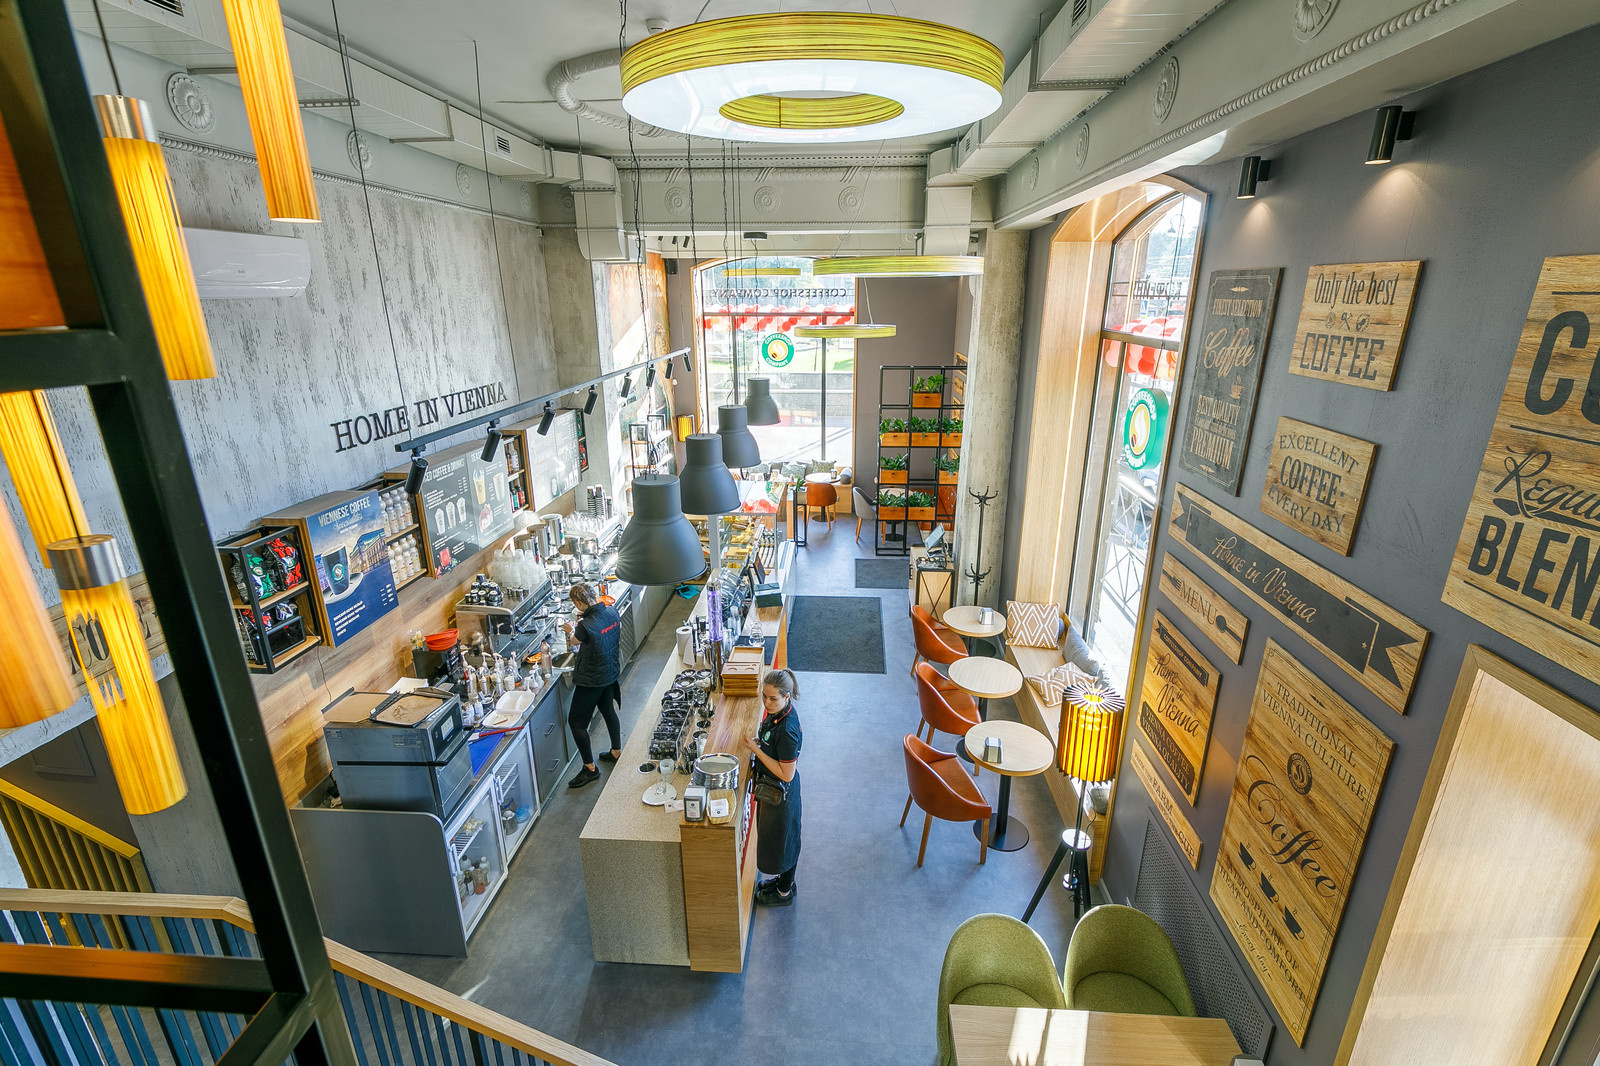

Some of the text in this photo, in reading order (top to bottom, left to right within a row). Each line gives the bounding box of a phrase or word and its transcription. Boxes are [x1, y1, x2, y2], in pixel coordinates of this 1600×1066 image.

[1212, 299, 1263, 318] FINEST SELECTION
[1314, 271, 1400, 309] Only the best
[765, 333, 793, 346] COFFEESHOP
[765, 356, 789, 368] COMPANY
[1203, 327, 1256, 379] Coffee
[1300, 332, 1385, 380] COFFEE
[330, 381, 508, 453] HOME IN VIENNA
[1196, 394, 1241, 427] BEST QUALITY
[1190, 426, 1235, 470] PREMIUM
[1279, 434, 1359, 475] EXCELLENT
[1280, 455, 1342, 509] COFFEE
[318, 496, 371, 528] VIENNESE COFFEE
[1267, 484, 1346, 533] EVERY DAY
[1179, 579, 1219, 626] MENU
[1211, 536, 1317, 624] Home in Vienna
[1153, 653, 1179, 685] Home
[1156, 683, 1199, 738] Vienna
[1276, 682, 1357, 768] TRADITIONAL
[1142, 717, 1190, 791] VIENNA QUALITY
[1145, 706, 1191, 775] VIENNA COFFEE
[1262, 689, 1367, 801] VIENNA CULTURE
[1152, 777, 1173, 816] FARM
[1178, 830, 1195, 858] CUP
[1245, 755, 1337, 898] Coffee
[1219, 866, 1306, 1001] HEAT AND COMFORT
[1228, 863, 1300, 971] ATMOSPHERE OF
[1238, 923, 1269, 974] Every day
